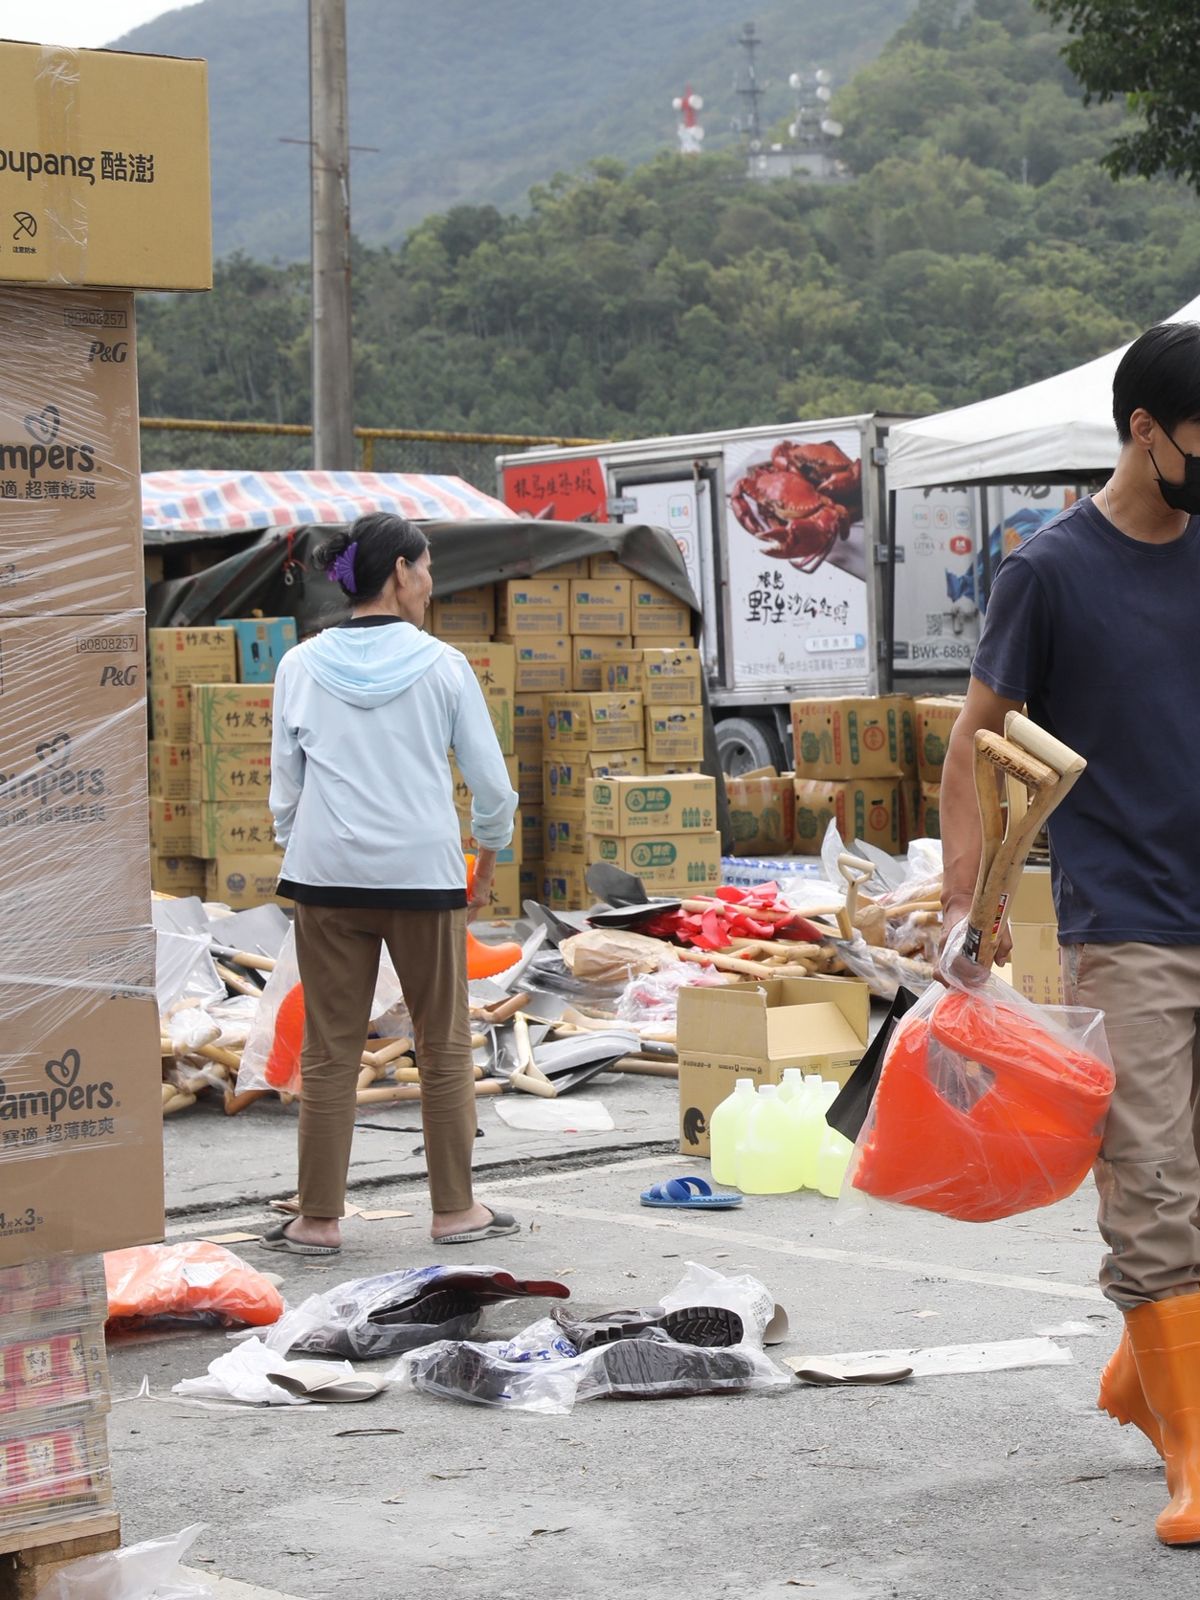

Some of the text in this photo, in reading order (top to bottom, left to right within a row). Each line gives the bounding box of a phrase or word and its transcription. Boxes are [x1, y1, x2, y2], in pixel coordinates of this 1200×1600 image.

[101, 150, 154, 184] 酷澎
[88, 341, 128, 363] P&G
[80, 637, 135, 651] 80808257
[186, 632, 226, 647] 竹炭水
[912, 646, 970, 659] BWK-6869
[100, 665, 138, 687] P&G
[45, 1116, 115, 1143] 超薄乾爽
